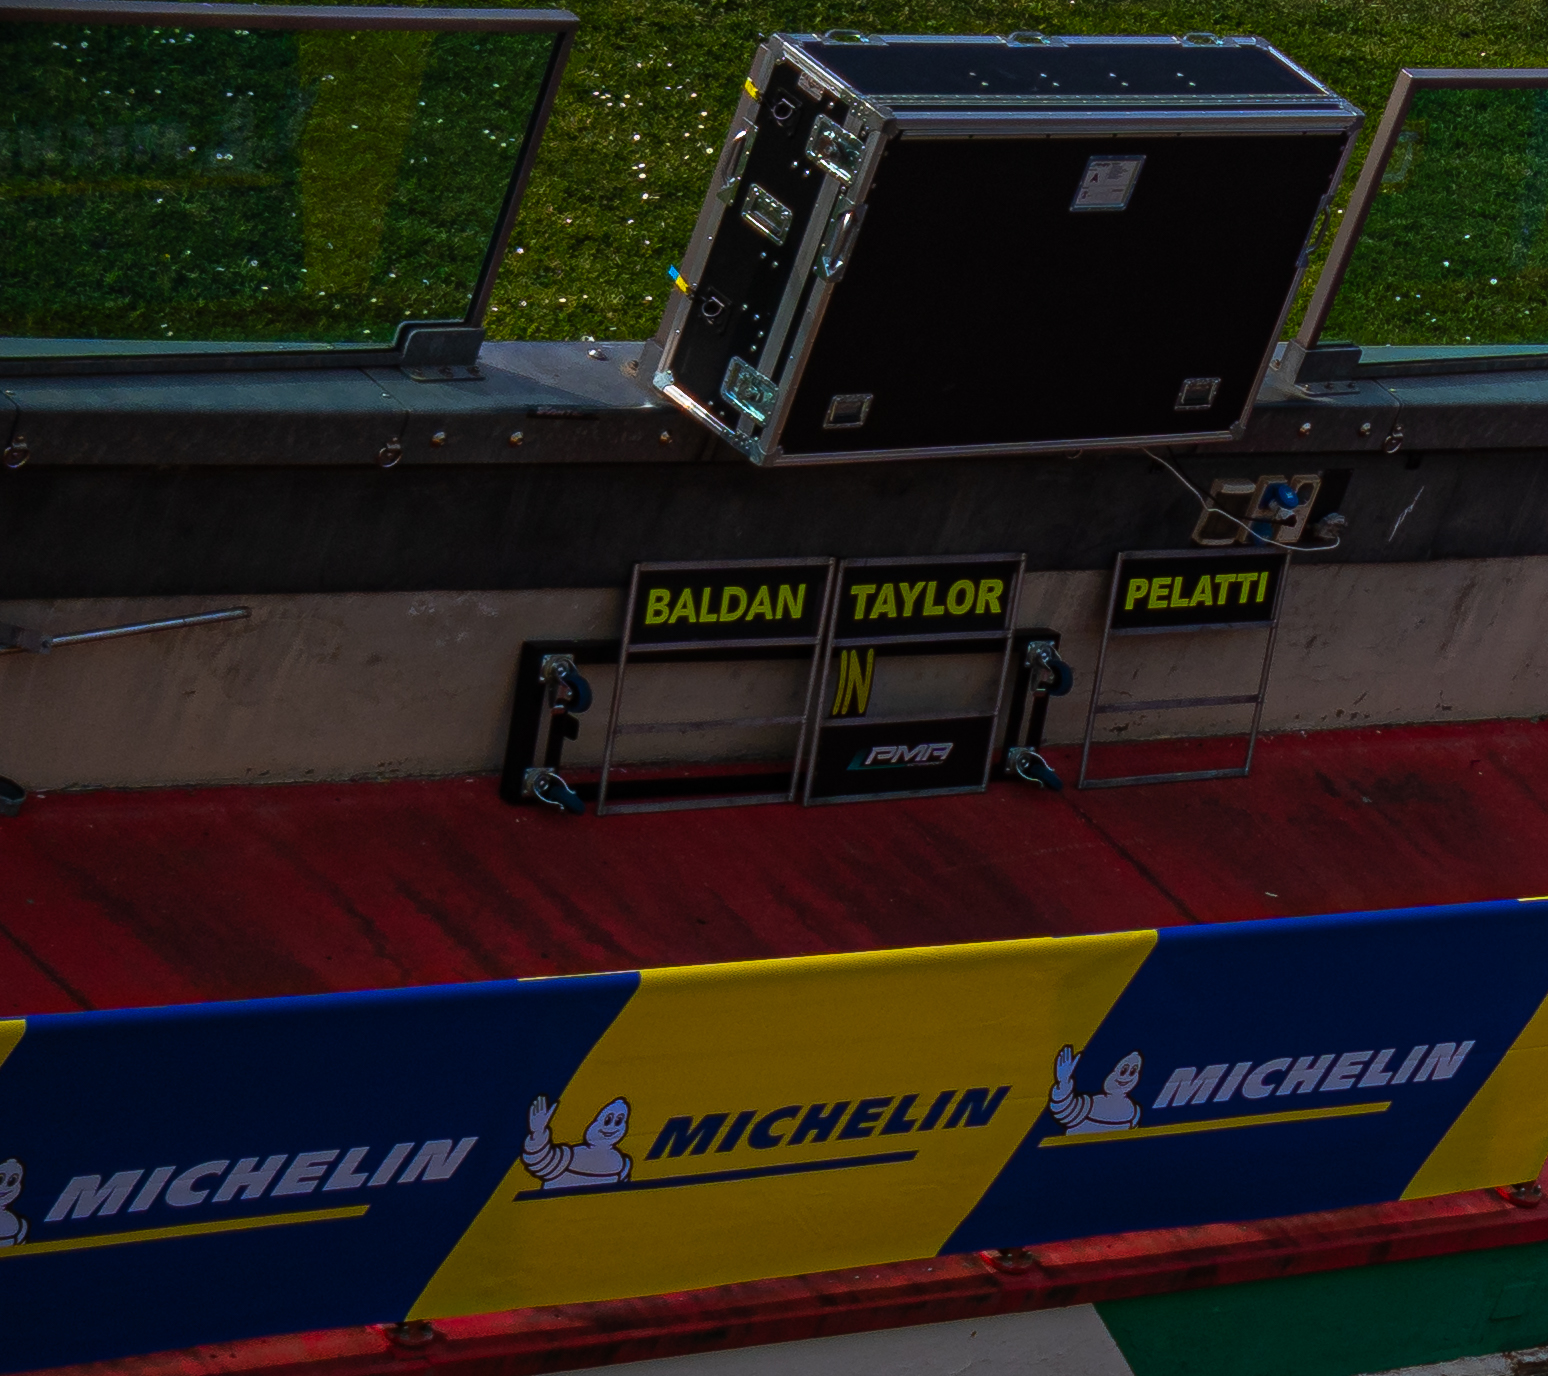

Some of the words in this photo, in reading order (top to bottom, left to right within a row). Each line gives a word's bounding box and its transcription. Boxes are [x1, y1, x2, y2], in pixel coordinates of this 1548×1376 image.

[644, 584, 806, 625] BALDAN
[850, 578, 1004, 621] TAYLOR
[1124, 571, 1269, 611] PELATTI
[832, 648, 876, 717] IN
[1152, 1040, 1476, 1109] MICHELIN
[645, 1086, 1012, 1161] MICHELIN
[44, 1136, 479, 1223] MICHELIN
